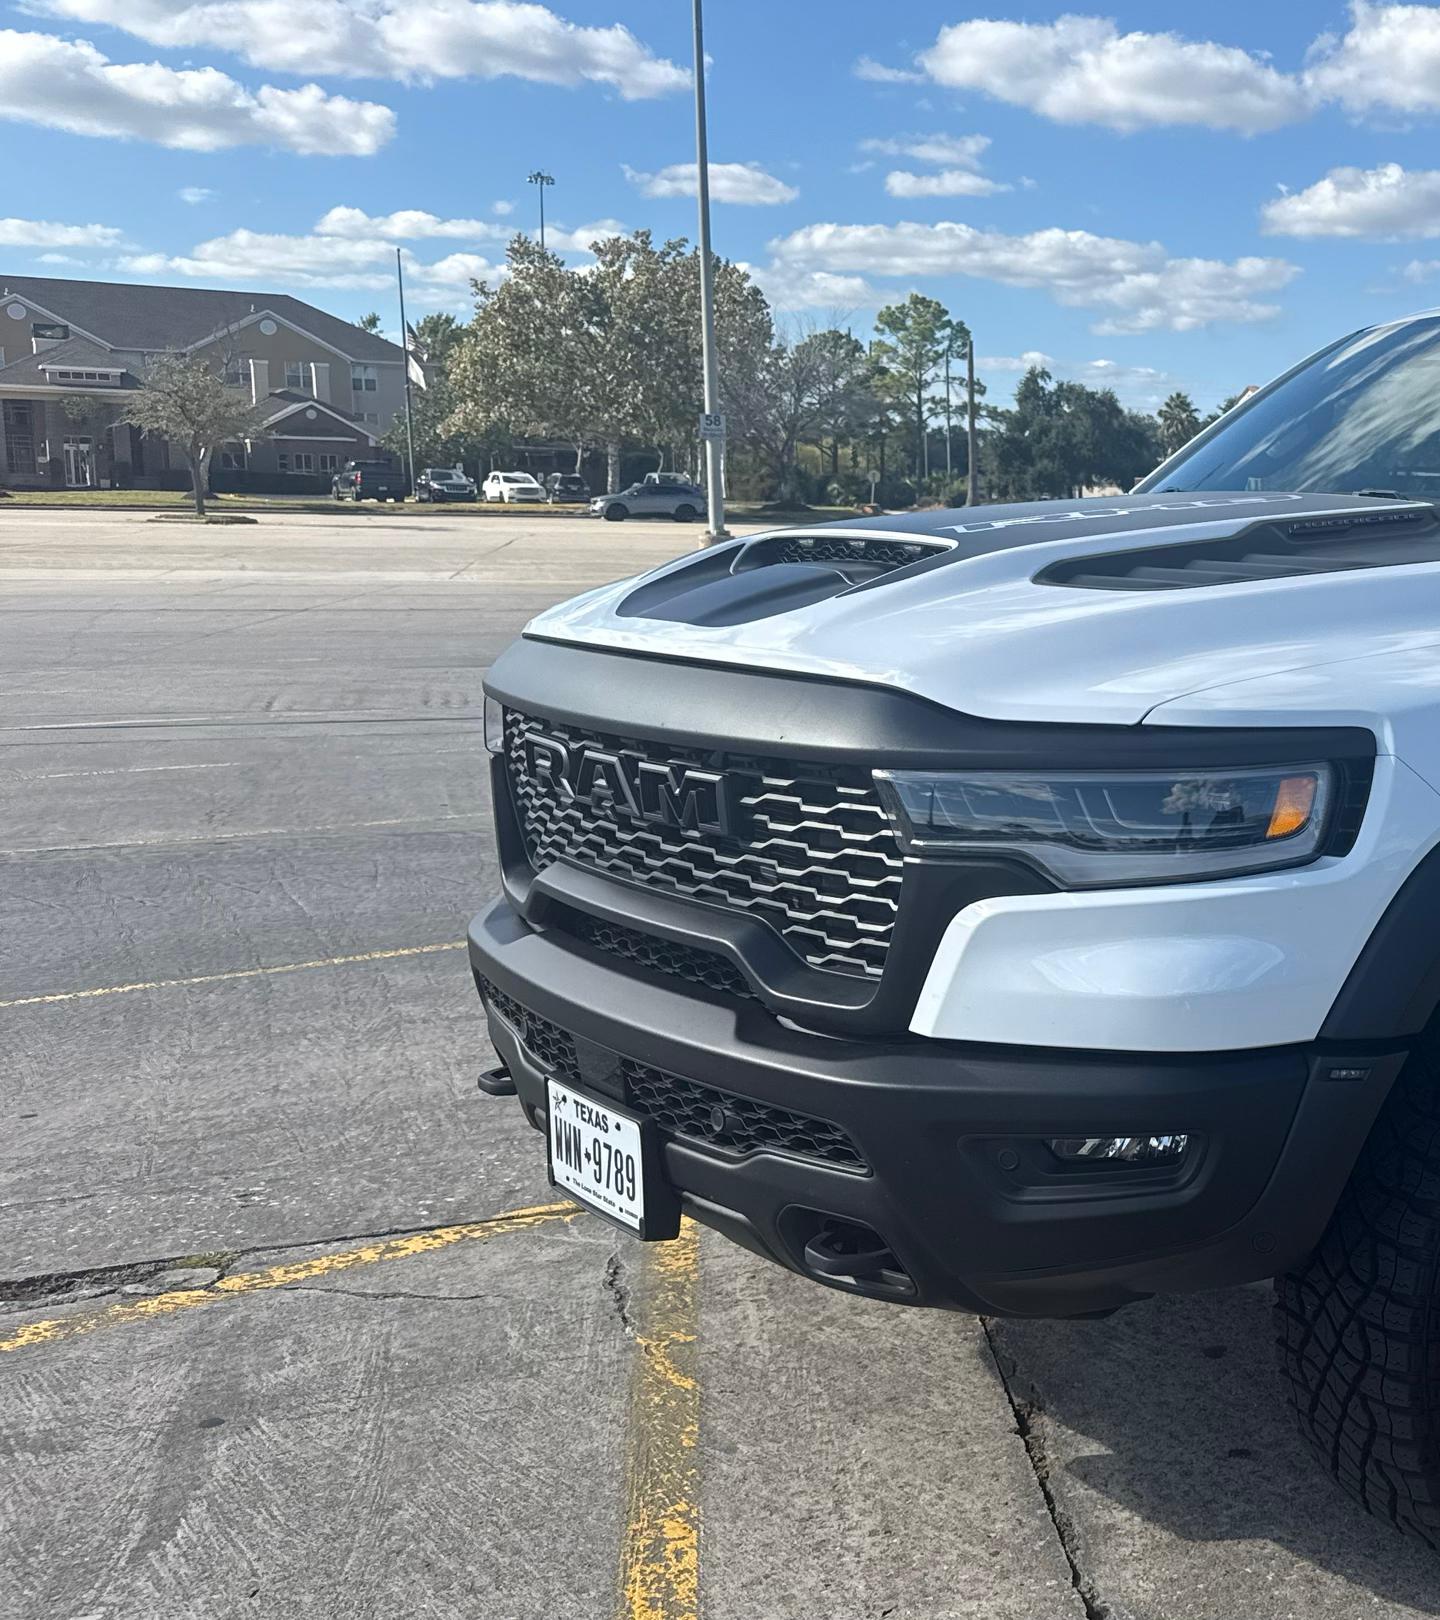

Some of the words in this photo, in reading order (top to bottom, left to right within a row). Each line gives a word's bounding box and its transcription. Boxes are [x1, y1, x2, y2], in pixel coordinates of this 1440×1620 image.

[705, 415, 721, 426] 58
[524, 731, 729, 837] RAM
[573, 1099, 609, 1134] TEXAS
[572, 1177, 581, 1188] The
[581, 1183, 592, 1194] Lone
[592, 1189, 602, 1200] Star
[603, 1195, 616, 1208] State
